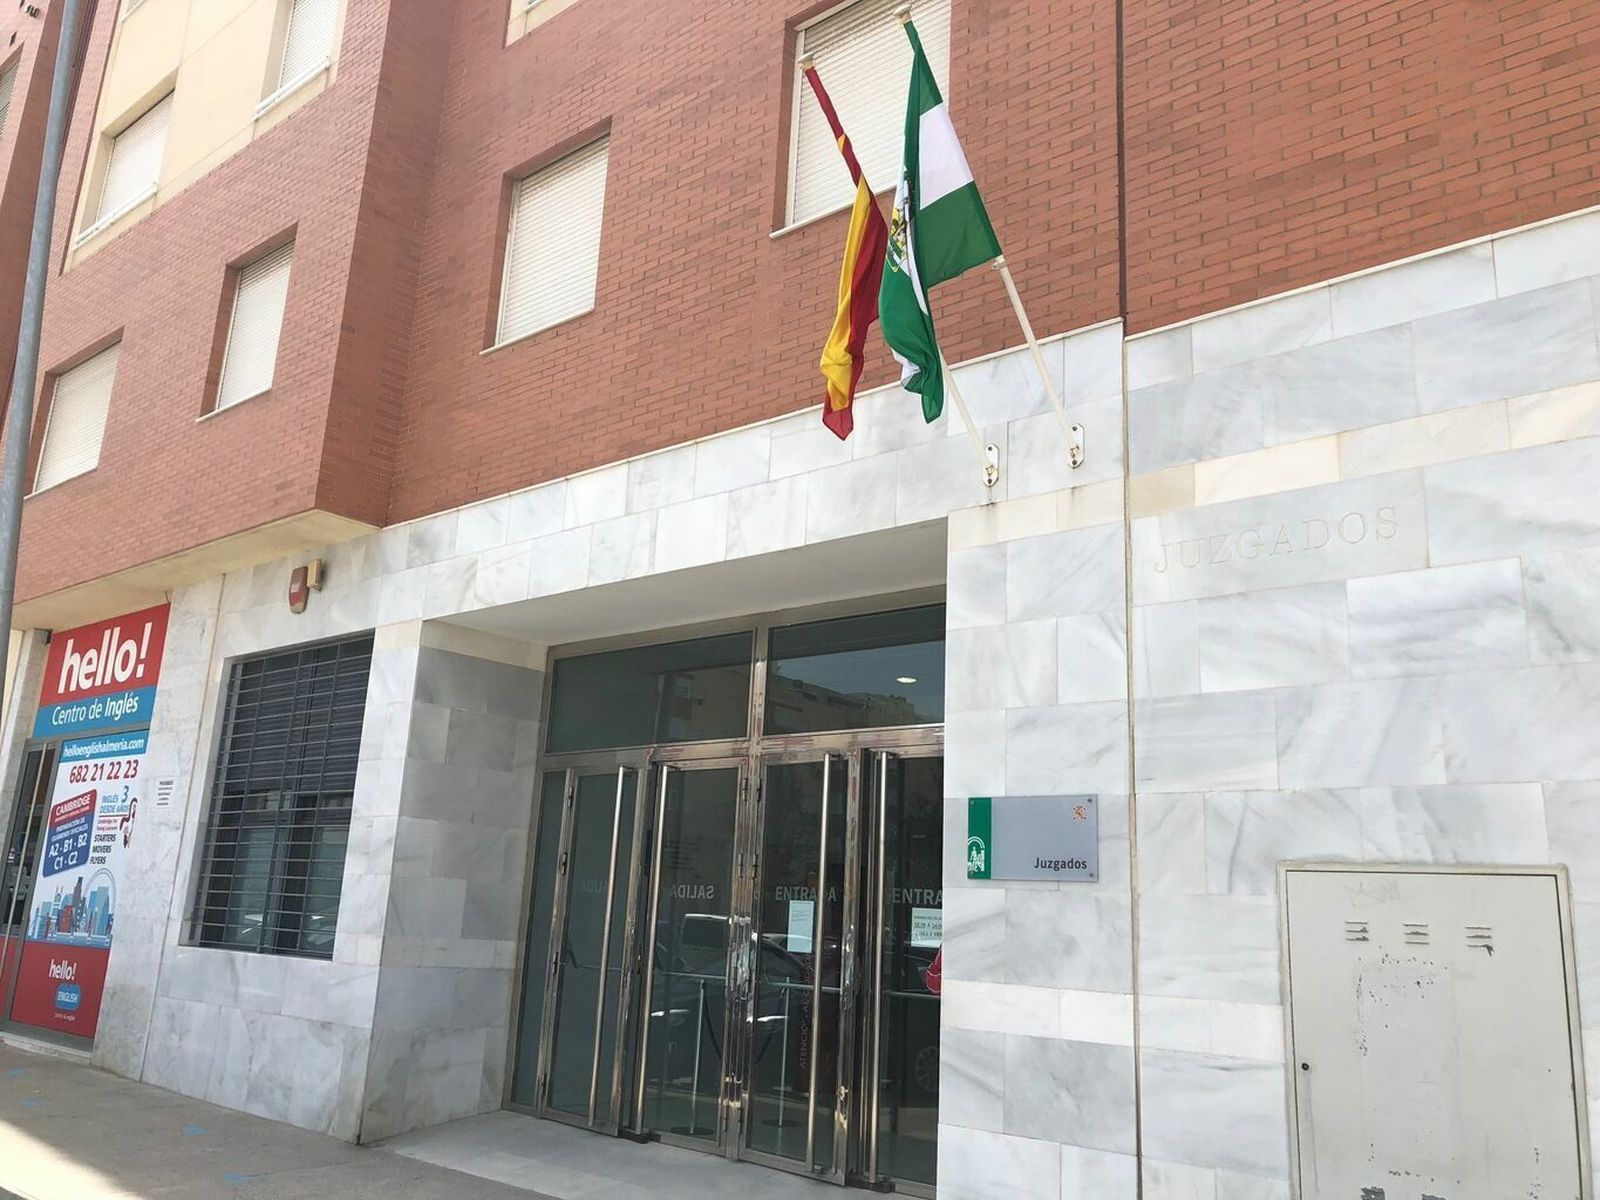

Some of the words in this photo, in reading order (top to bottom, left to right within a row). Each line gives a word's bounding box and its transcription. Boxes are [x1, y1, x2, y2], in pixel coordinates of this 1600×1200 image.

[1154, 506, 1398, 573] JUZGADOS
[57, 621, 152, 694] hello!
[52, 706, 85, 726] Centro
[88, 699, 101, 721] de
[104, 692, 139, 721] Inglés
[69, 765, 89, 784] 682
[90, 763, 104, 781] 21
[106, 761, 122, 779] 22
[123, 759, 139, 778] 23
[121, 785, 130, 803] 3
[48, 844, 59, 858] A2
[63, 838, 73, 853] B1
[78, 833, 88, 848] B2
[94, 833, 117, 843] STARTERS
[92, 845, 112, 854] MOVERS
[68, 852, 78, 866] C2
[90, 856, 107, 865] FLYERS
[1034, 857, 1088, 872] Juzgados
[775, 886, 837, 902] ENTRAA
[892, 888, 943, 905] ENTRA
[48, 958, 77, 980] hello!
